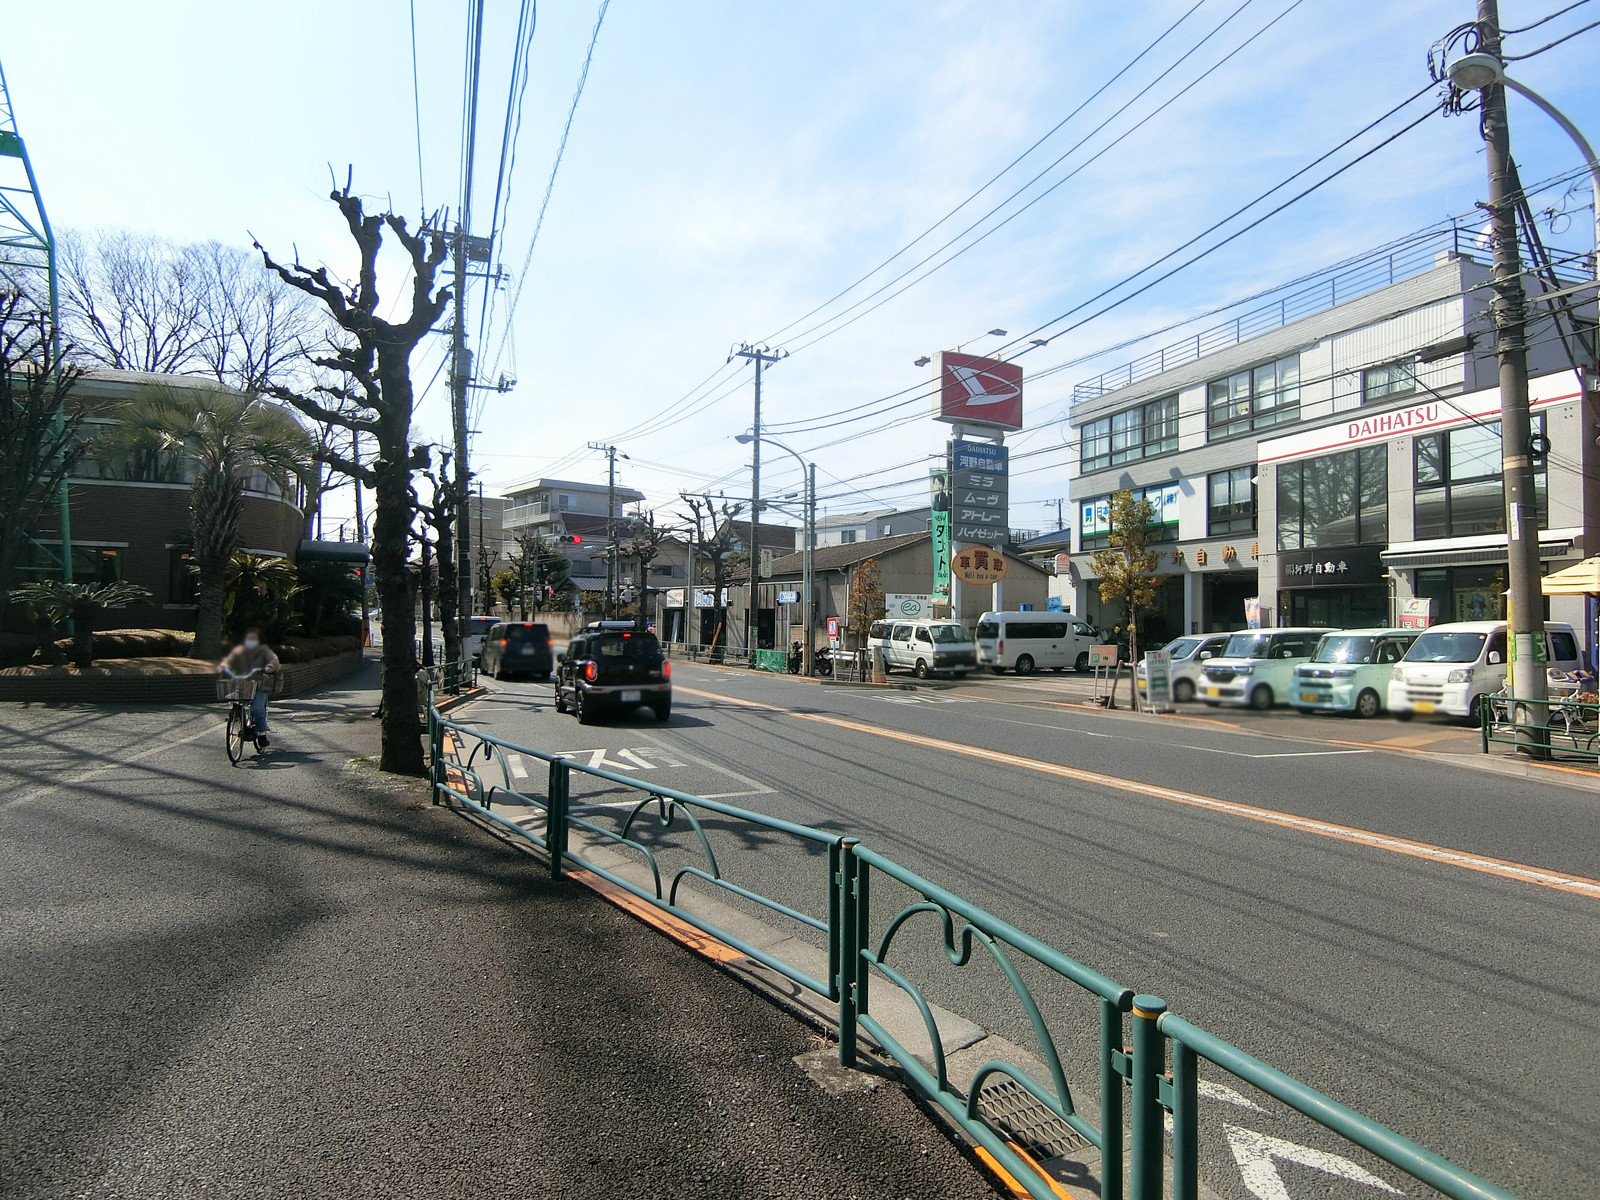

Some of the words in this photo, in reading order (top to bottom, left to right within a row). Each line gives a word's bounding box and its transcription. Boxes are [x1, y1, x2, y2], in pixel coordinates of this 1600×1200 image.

[1348, 404, 1438, 439] DAIHATSU
[967, 445, 997, 456] DAIHATSU
[959, 455, 1004, 472] 河野自動車
[968, 475, 995, 488] ミラ
[963, 491, 1000, 506] ムーヴ
[960, 509, 1001, 522] アトレー
[957, 527, 1004, 540] ハイゼット
[935, 525, 947, 571] タント
